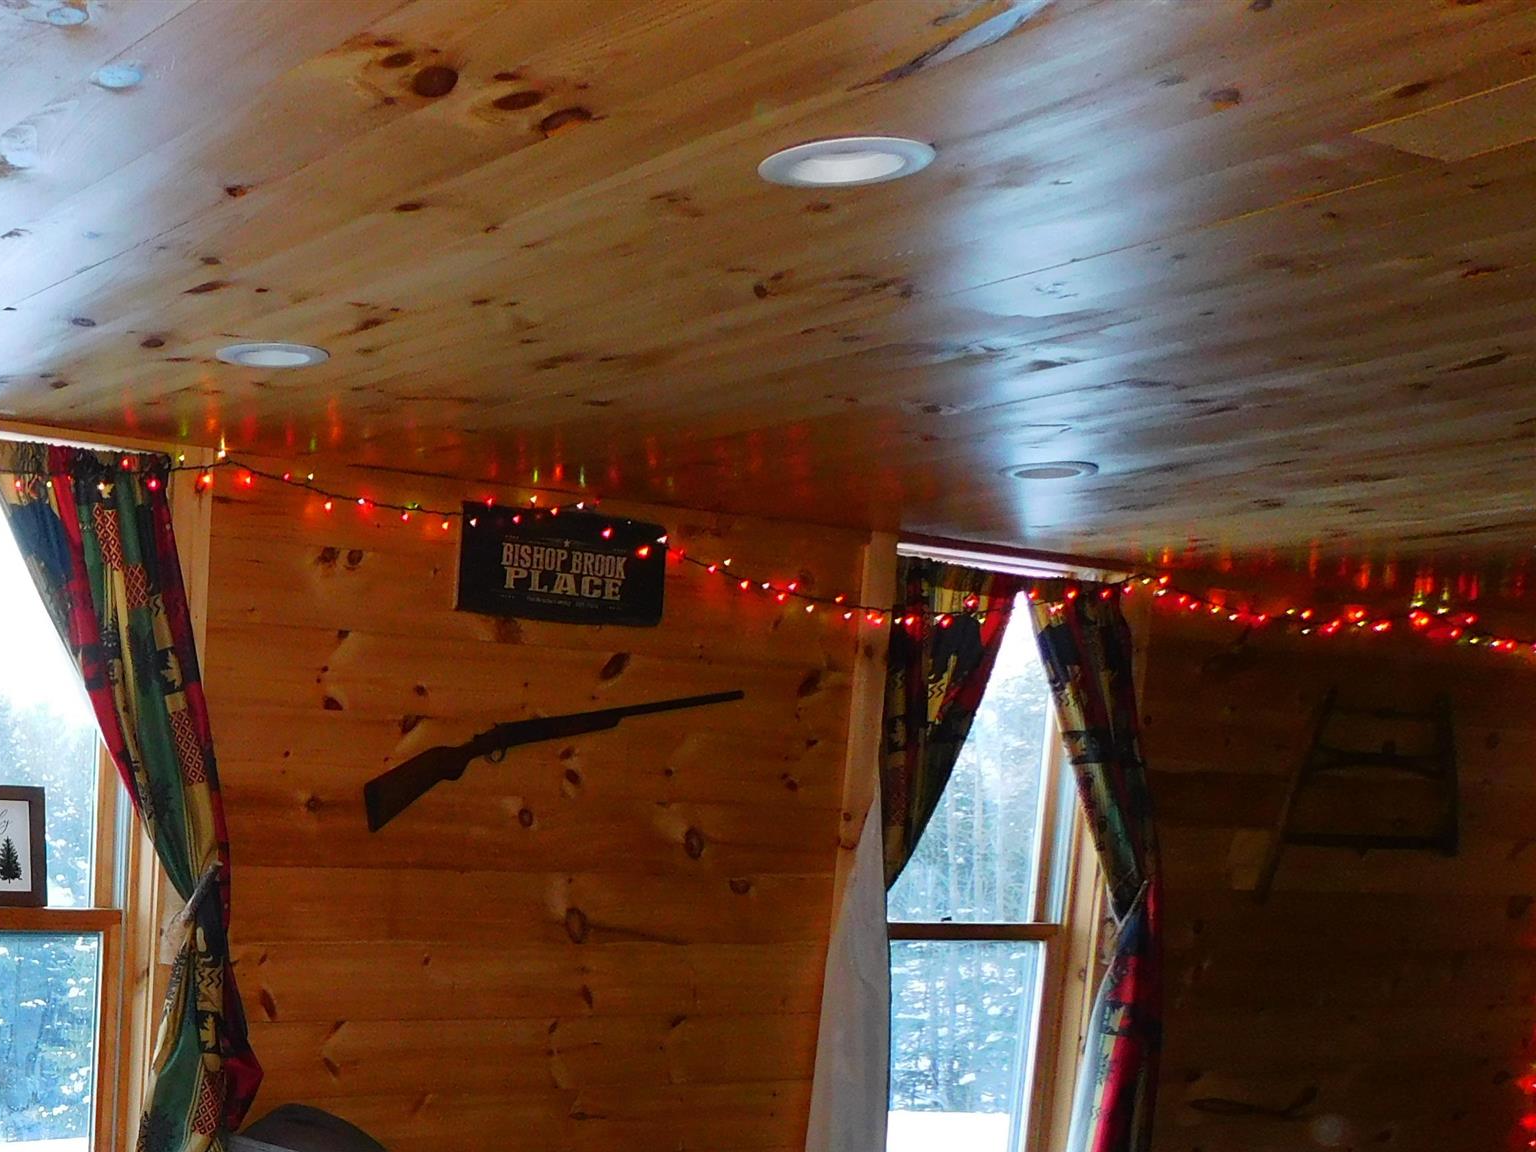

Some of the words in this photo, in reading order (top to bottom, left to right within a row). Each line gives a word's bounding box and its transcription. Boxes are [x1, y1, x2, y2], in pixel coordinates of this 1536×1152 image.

[500, 542, 568, 572] BISHOP
[569, 551, 628, 580] BROOK
[503, 566, 623, 600] PLACE
